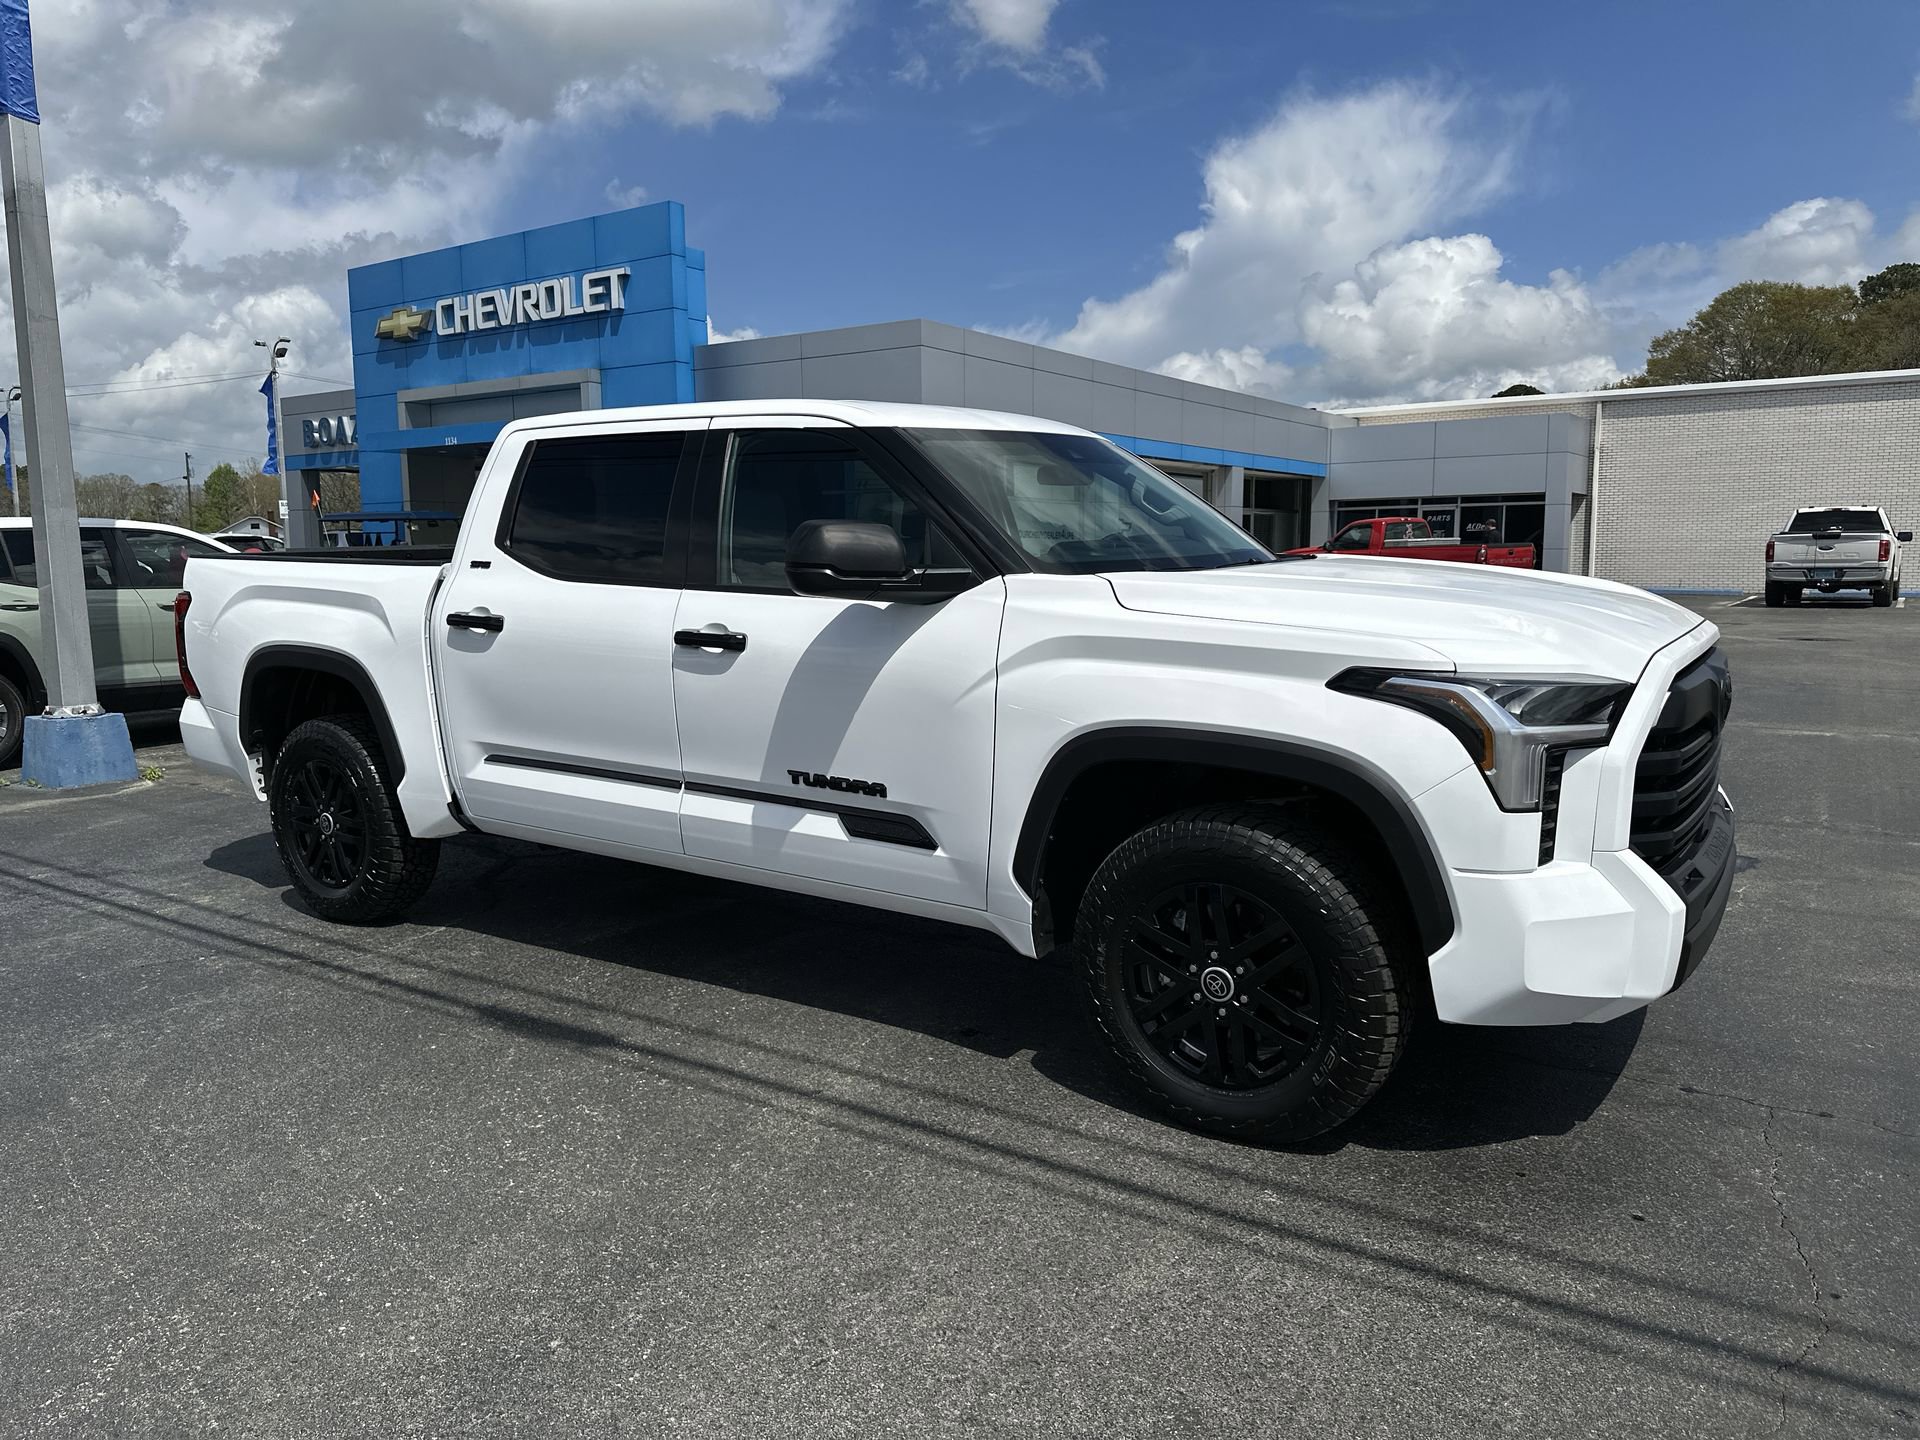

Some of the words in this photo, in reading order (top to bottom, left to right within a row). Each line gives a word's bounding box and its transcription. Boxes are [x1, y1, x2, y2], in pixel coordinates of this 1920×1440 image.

[435, 266, 629, 336] CHEVROLET
[1466, 523, 1487, 531] ACDe
[786, 769, 888, 799] TUNDRA
